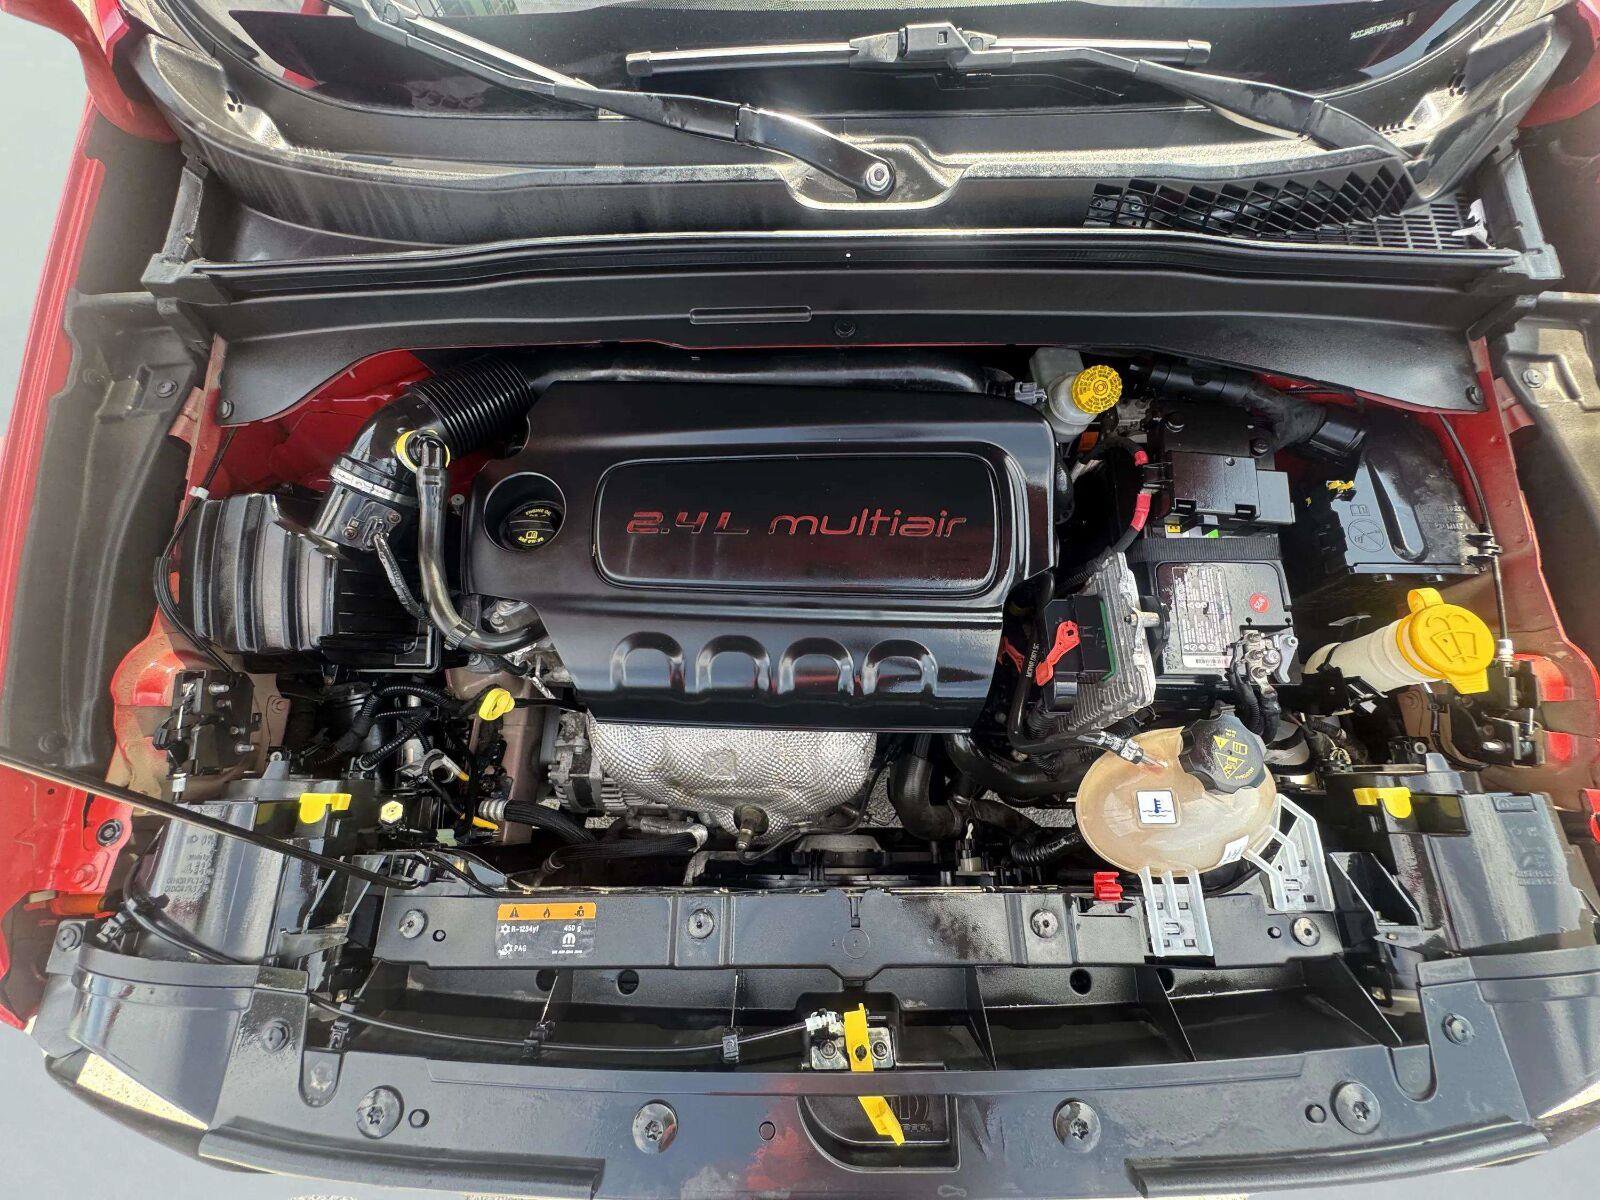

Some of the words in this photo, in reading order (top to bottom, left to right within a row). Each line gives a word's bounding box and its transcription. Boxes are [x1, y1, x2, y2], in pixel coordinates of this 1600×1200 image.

[768, 508, 968, 538] multiair
[511, 924, 540, 934] R-1234yf
[563, 924, 576, 932] 450
[513, 944, 527, 952] PAG
